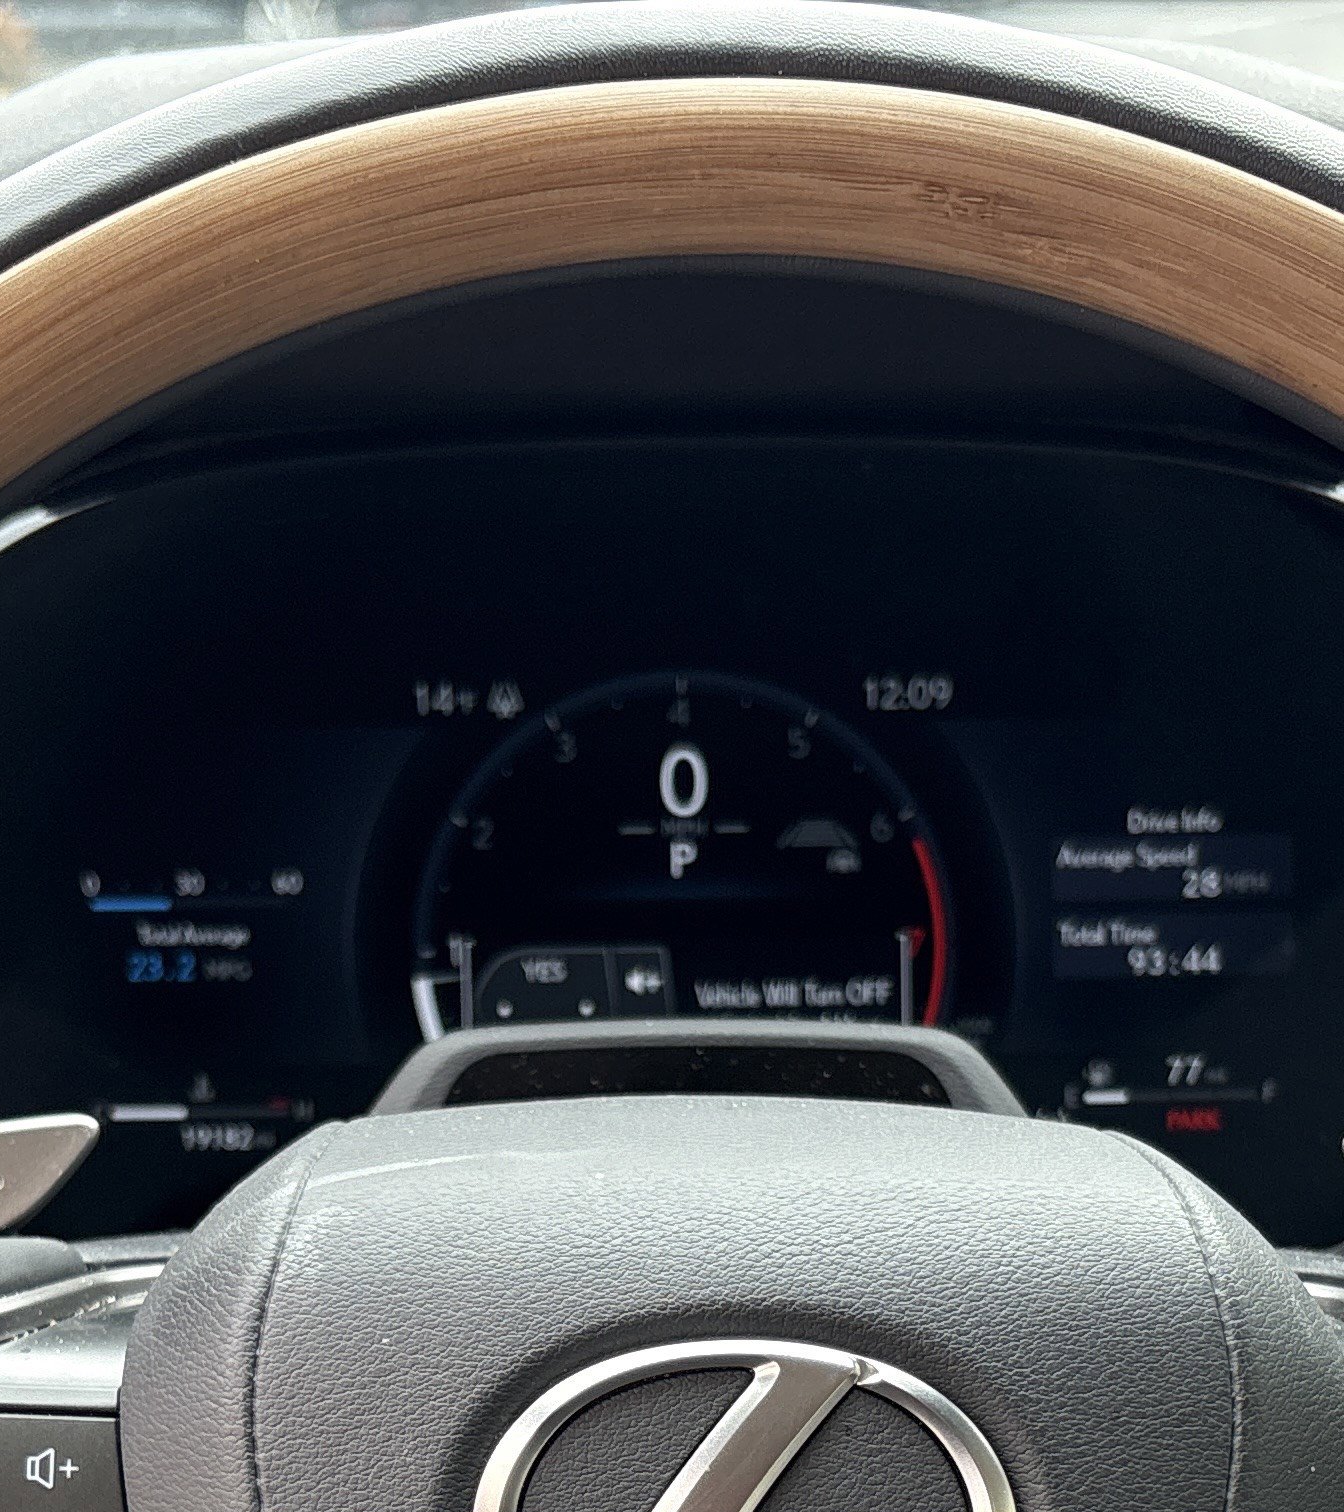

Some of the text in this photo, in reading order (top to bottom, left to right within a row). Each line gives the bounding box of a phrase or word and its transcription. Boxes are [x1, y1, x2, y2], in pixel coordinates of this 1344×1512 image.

[863, 674, 954, 711] 12:09
[659, 743, 709, 818] 0
[669, 841, 698, 880] P
[520, 957, 569, 985] YES
[1127, 944, 1223, 977] 93:44
